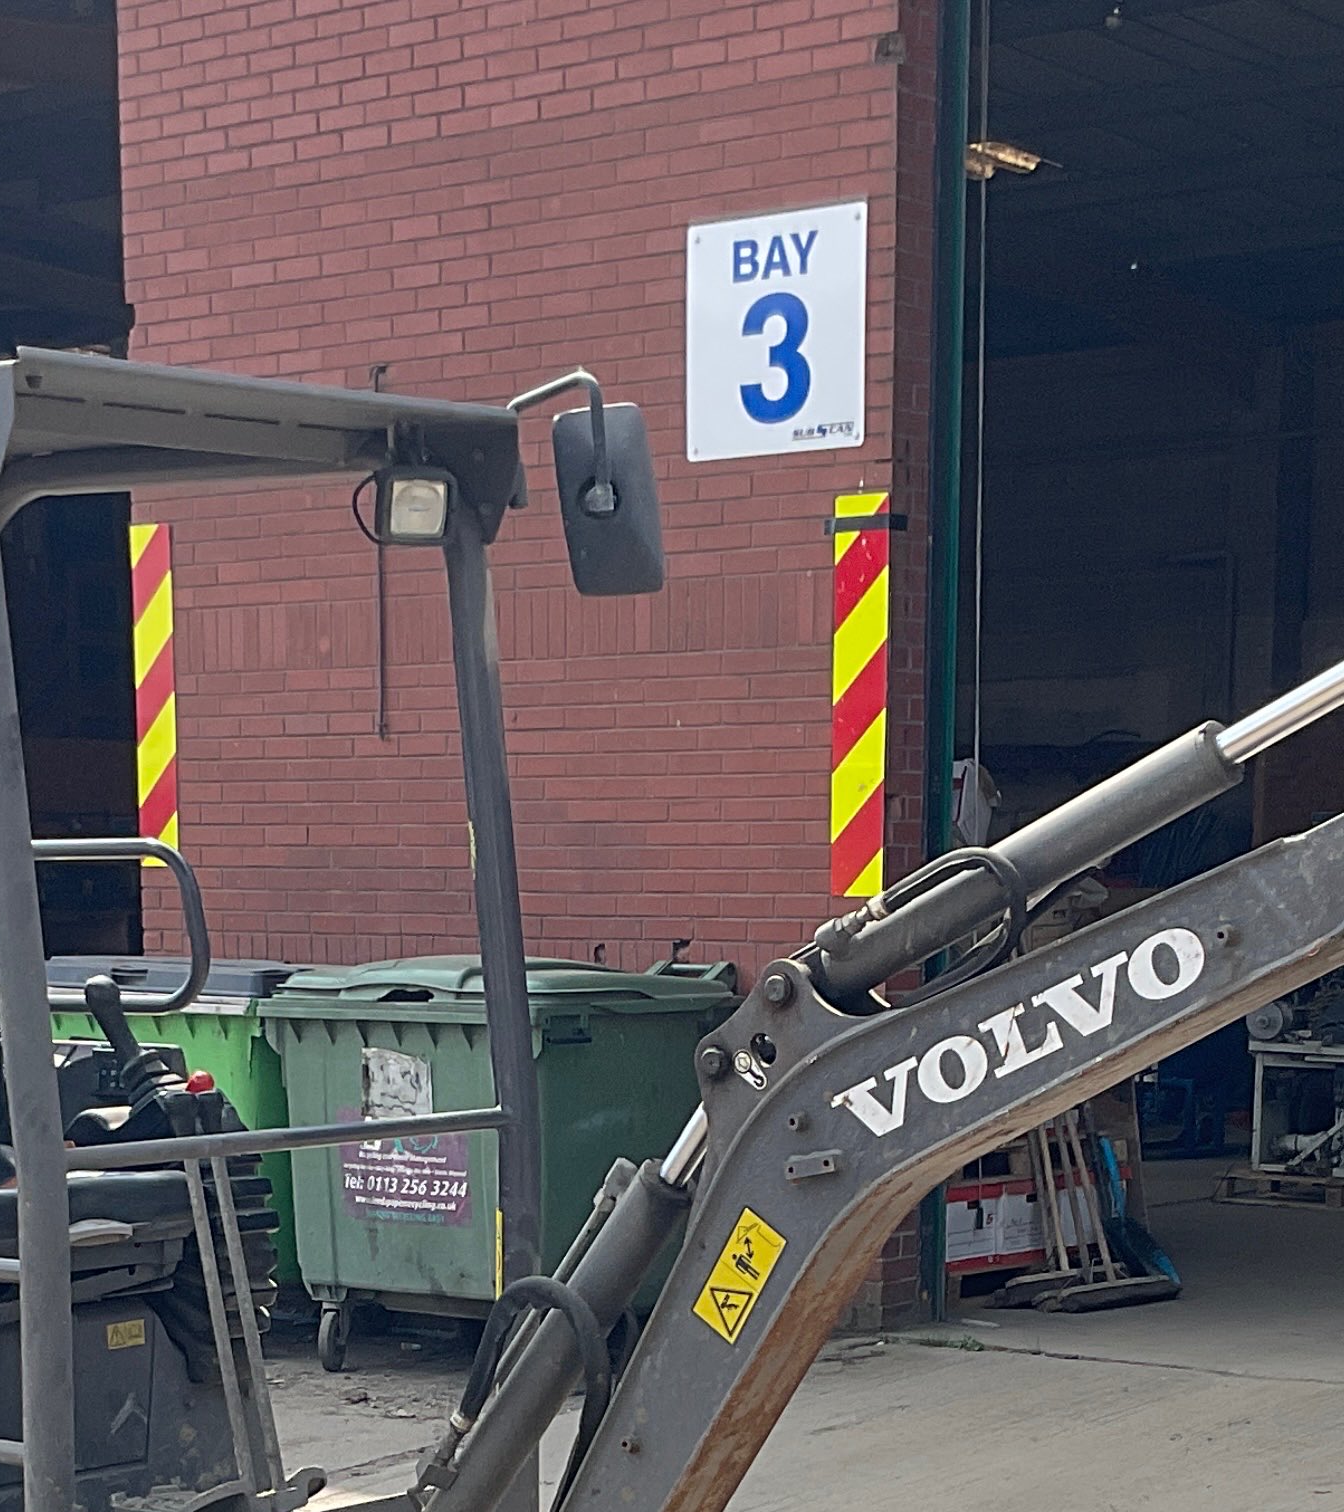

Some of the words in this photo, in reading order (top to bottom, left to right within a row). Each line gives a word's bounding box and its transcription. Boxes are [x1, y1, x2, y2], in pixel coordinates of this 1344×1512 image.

[732, 229, 819, 284] BAY
[739, 291, 812, 425] 3
[831, 928, 1205, 1137] VOLVO
[344, 1173, 365, 1190] Tel:
[367, 1175, 398, 1193] 0113
[400, 1179, 428, 1196] 256
[430, 1180, 468, 1198] 3244
